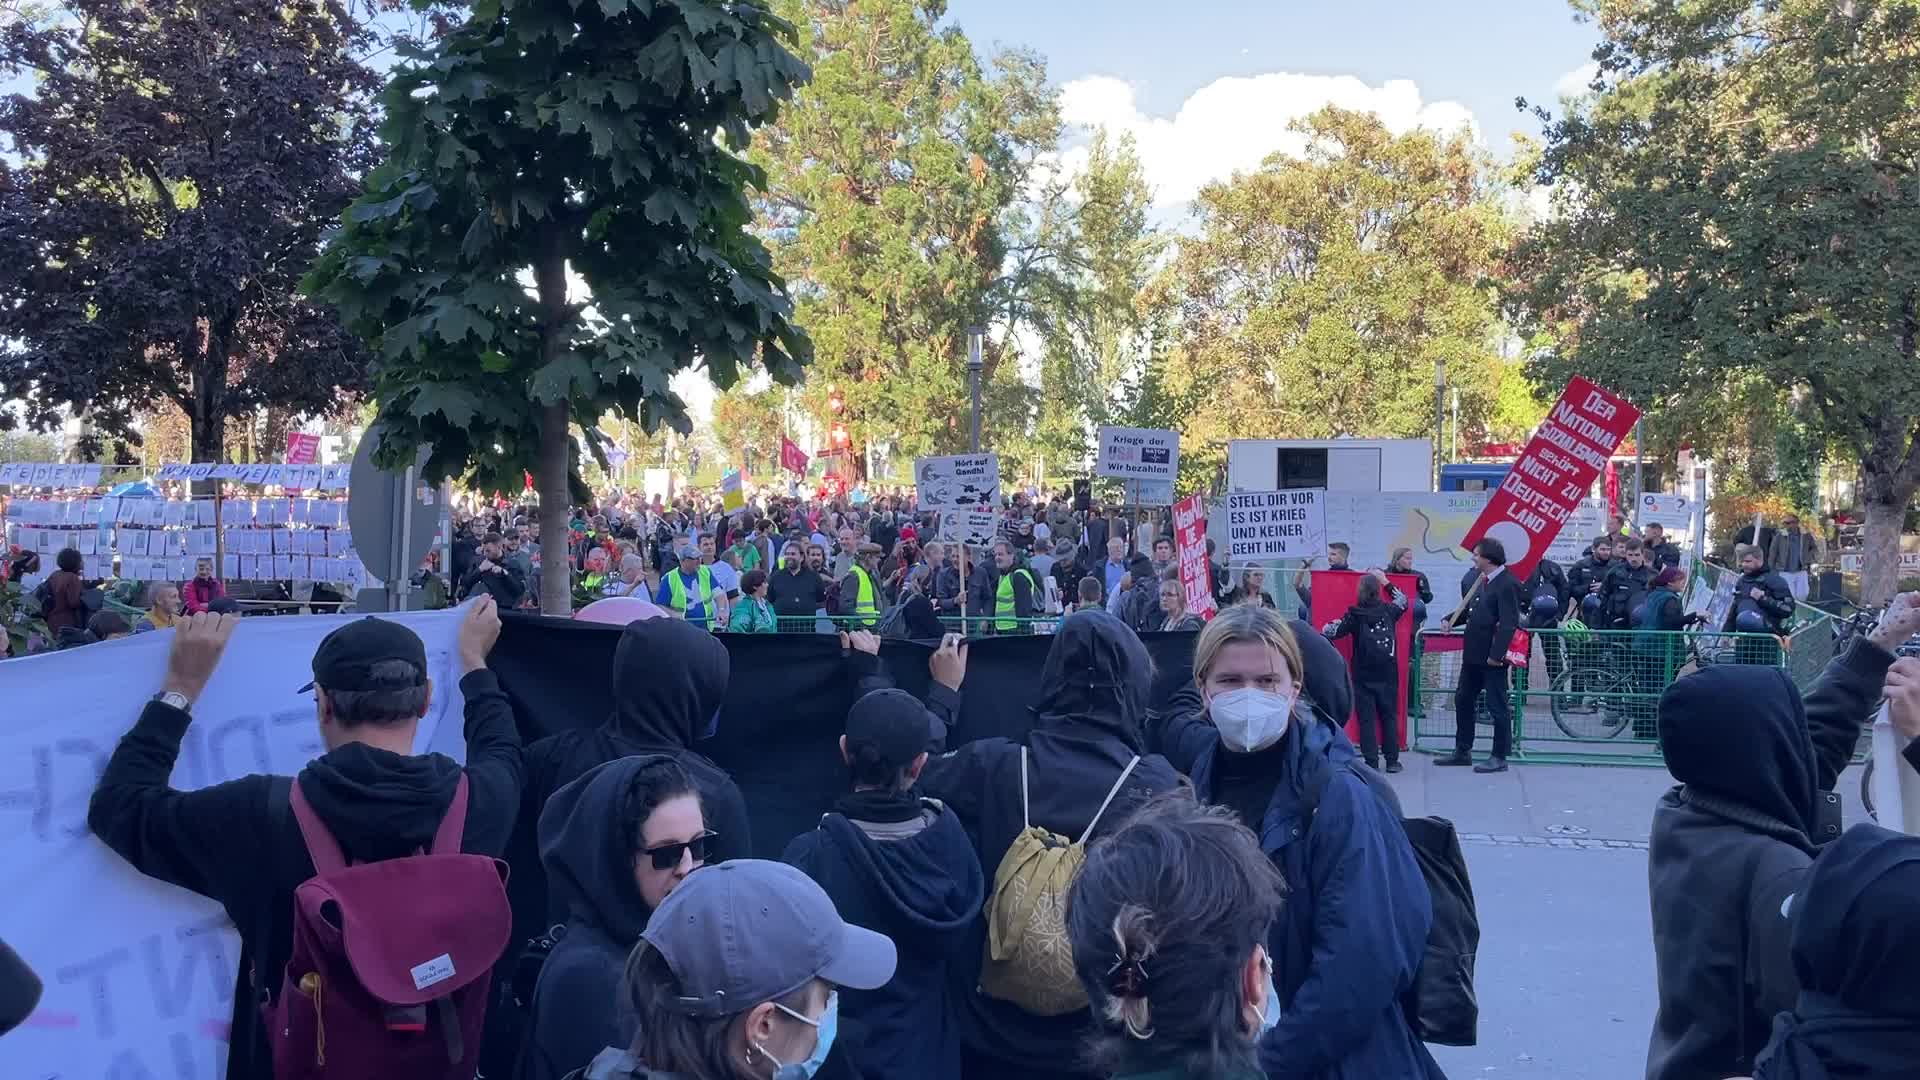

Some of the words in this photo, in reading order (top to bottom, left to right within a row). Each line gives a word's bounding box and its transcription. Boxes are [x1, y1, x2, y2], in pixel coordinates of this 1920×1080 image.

[1582, 390, 1616, 421] DER
[1552, 400, 1617, 451] NATIONAL
[974, 458, 988, 466] auf
[1108, 463, 1123, 471] Wir
[1126, 463, 1168, 473] bezahlen
[1520, 455, 1560, 486] NICHT
[1561, 481, 1582, 501] ZU
[1230, 495, 1264, 509] STELL
[1267, 493, 1287, 507] DIR
[1291, 491, 1314, 505] VOR
[1502, 471, 1570, 524] DEUTSCH
[1231, 511, 1245, 524] ES
[1249, 510, 1267, 523] IST
[1271, 507, 1306, 521] KRIEG
[1506, 501, 1547, 534] LAND
[1231, 527, 1256, 540] UND
[1259, 523, 1303, 538] KEINER
[1232, 542, 1261, 555] GEHT
[1265, 540, 1286, 553] HIN
